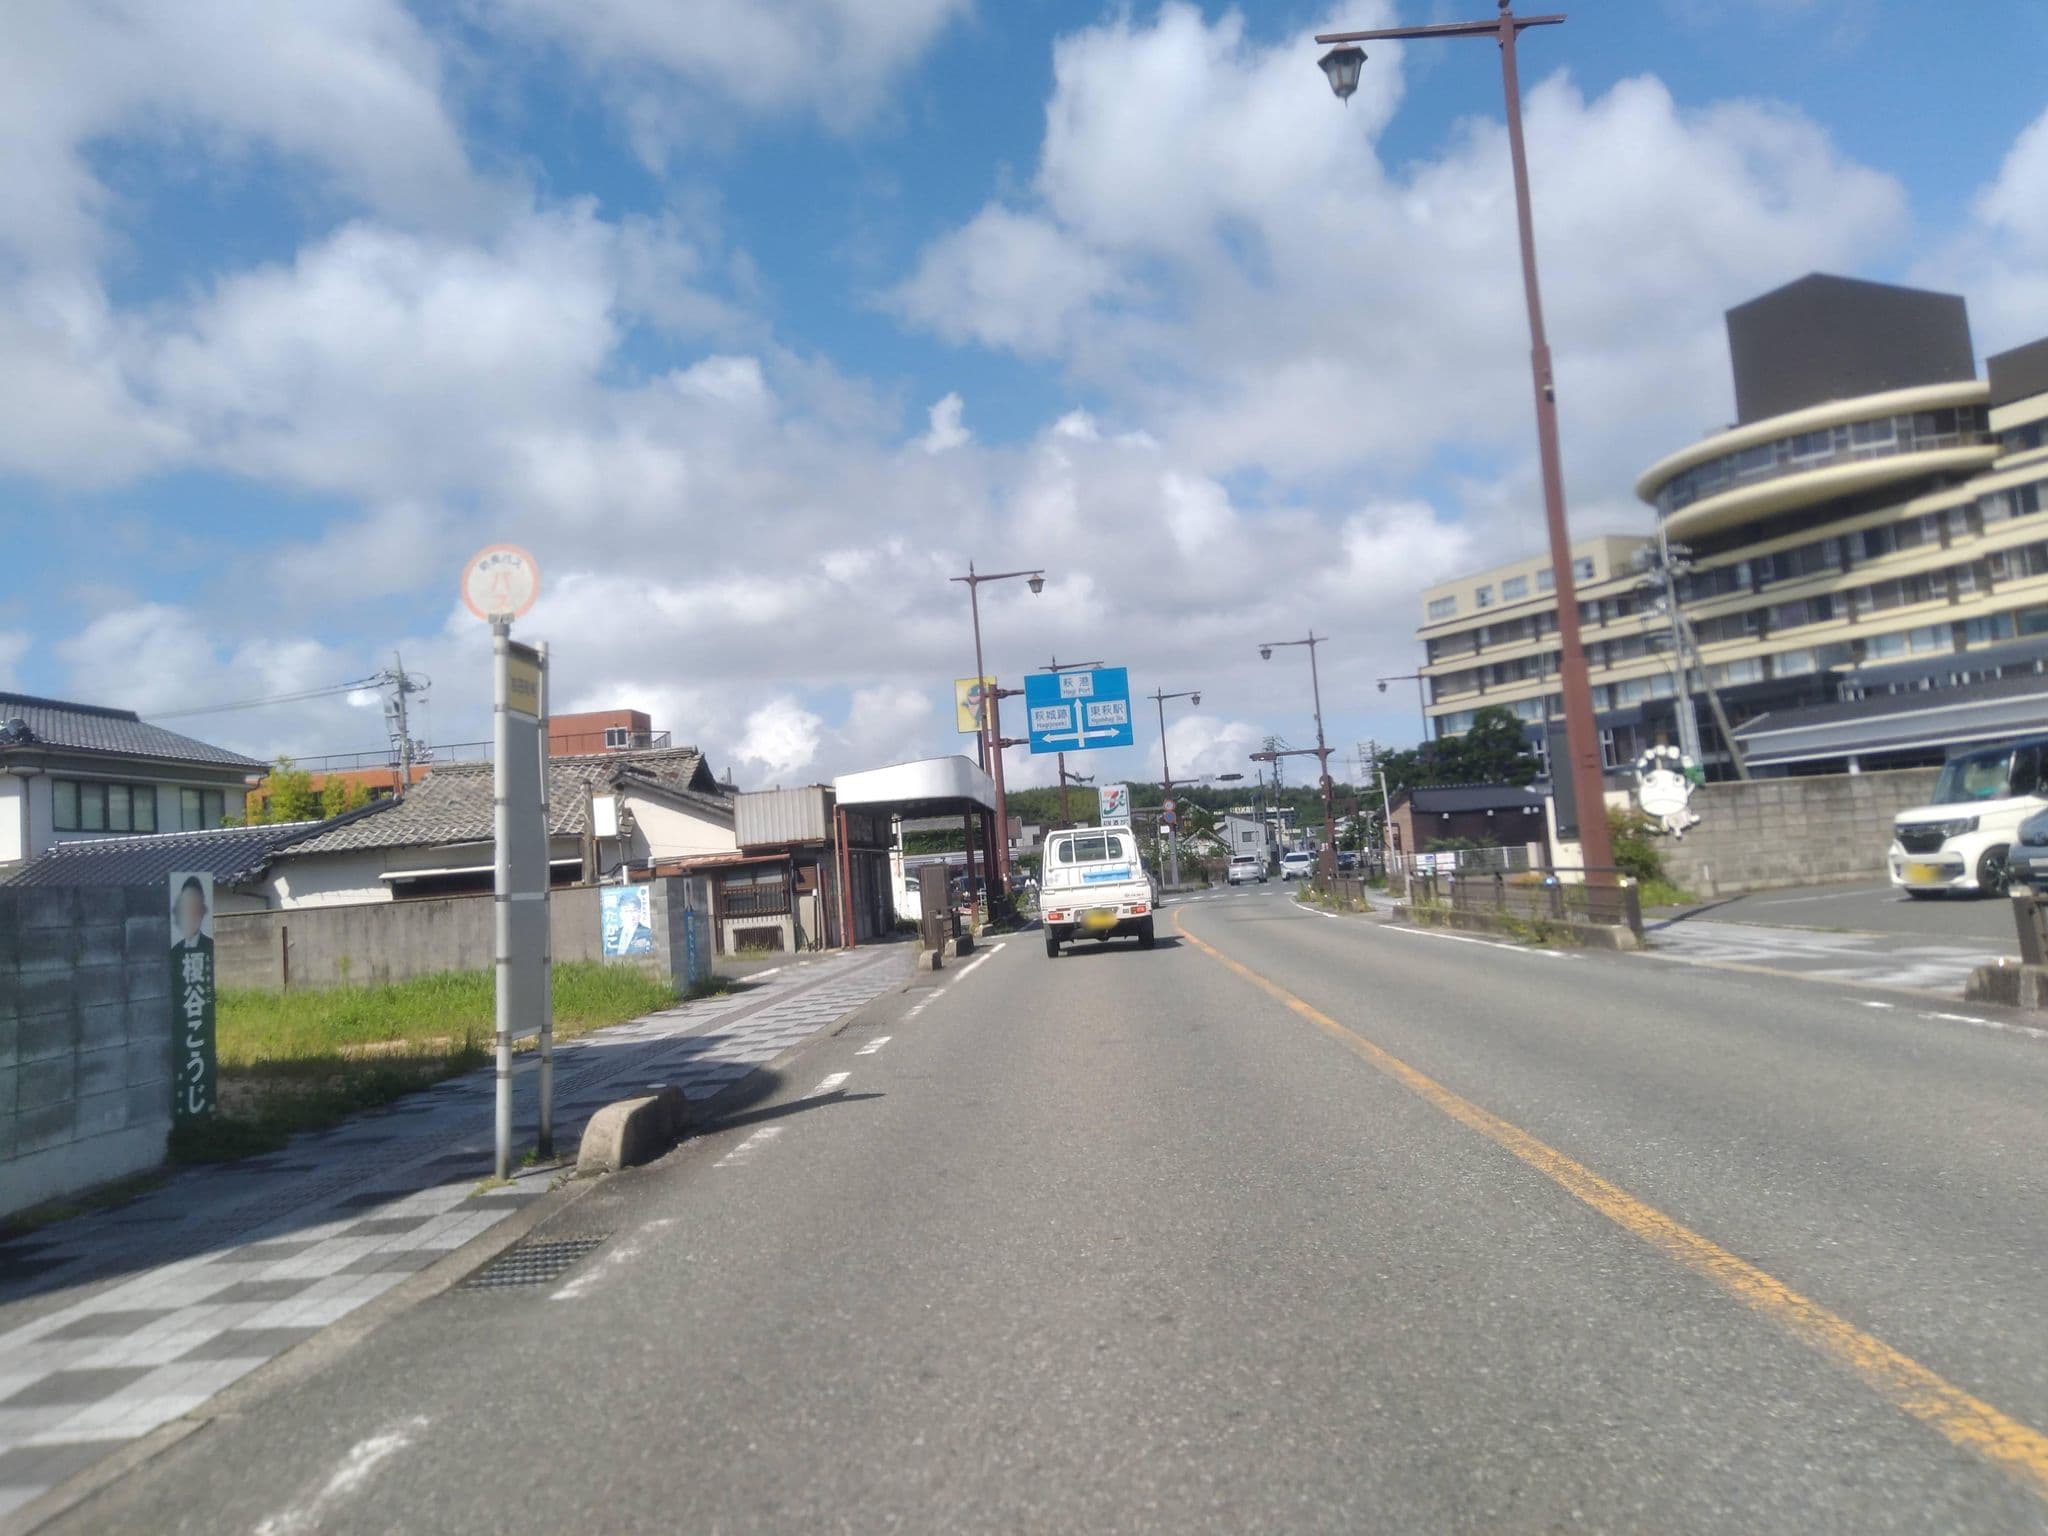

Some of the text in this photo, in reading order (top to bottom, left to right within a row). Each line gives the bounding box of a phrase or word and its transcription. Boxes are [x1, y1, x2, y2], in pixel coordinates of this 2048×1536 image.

[1034, 709, 1068, 721] 萩城跡
[1090, 703, 1124, 716] 東萩駅
[182, 952, 206, 1115] 榎谷こうじ
